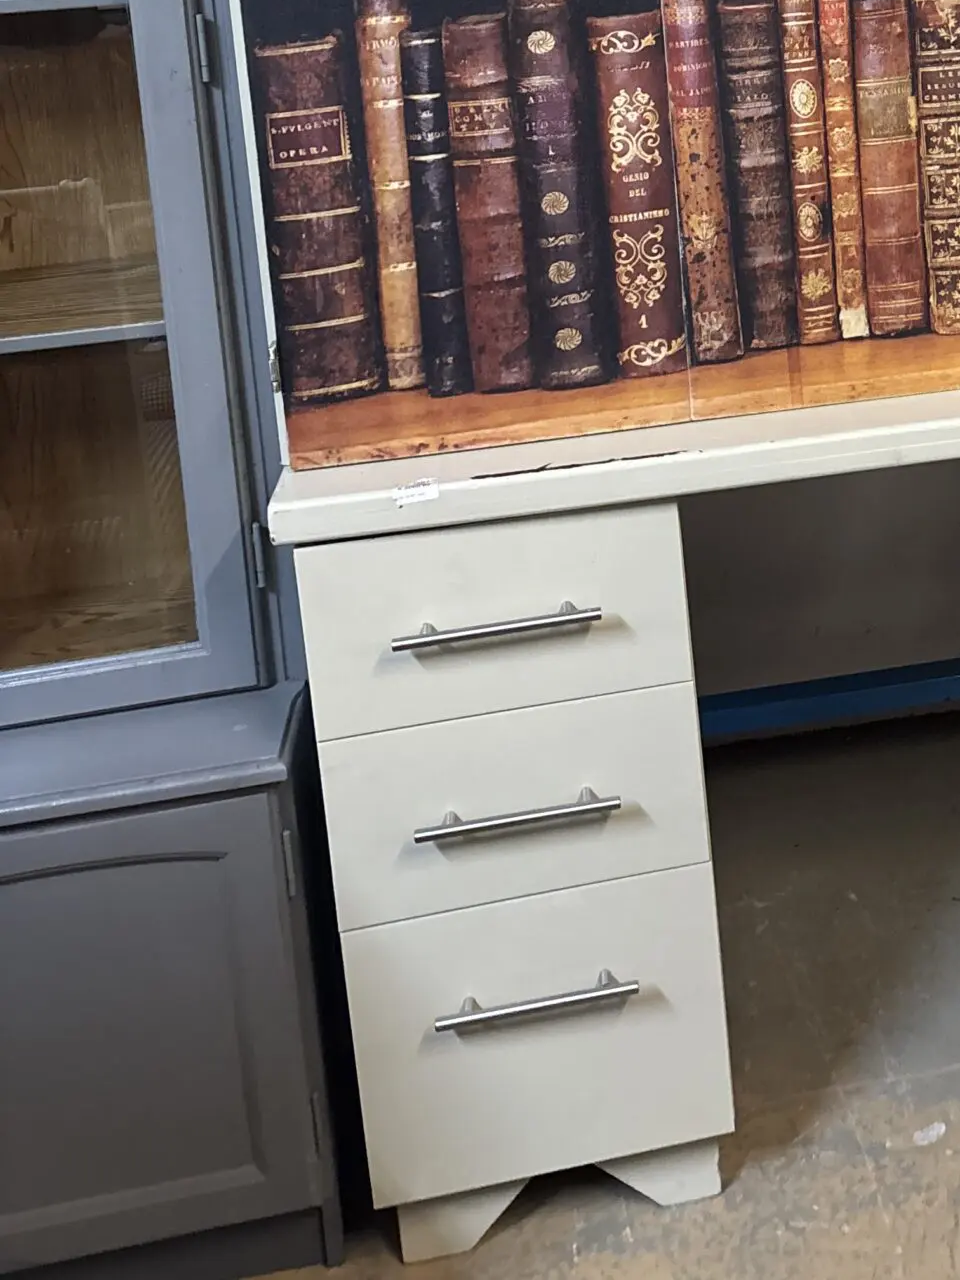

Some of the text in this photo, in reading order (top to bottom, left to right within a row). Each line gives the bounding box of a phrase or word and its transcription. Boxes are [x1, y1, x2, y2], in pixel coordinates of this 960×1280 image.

[279, 145, 330, 160] OPERA
[629, 189, 648, 198] DEL
[638, 313, 649, 329] 1
